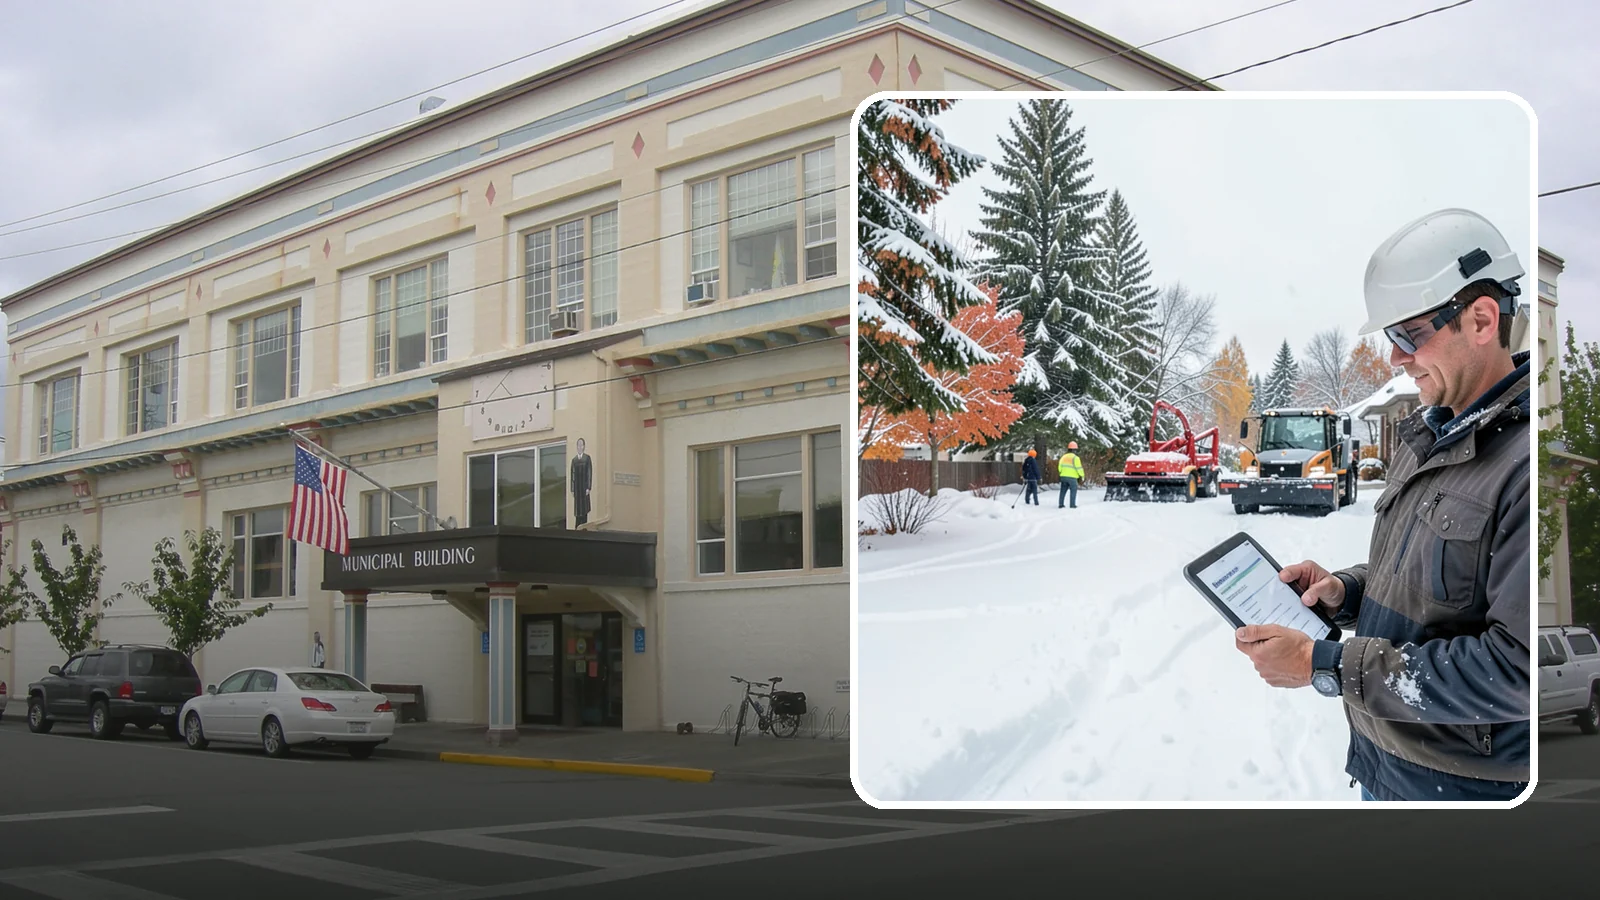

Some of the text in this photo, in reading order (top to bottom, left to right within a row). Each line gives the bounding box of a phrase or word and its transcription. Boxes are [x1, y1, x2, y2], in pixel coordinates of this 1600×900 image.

[507, 425, 513, 433] 12
[342, 546, 475, 572] MUNICIPAL BUILDING
